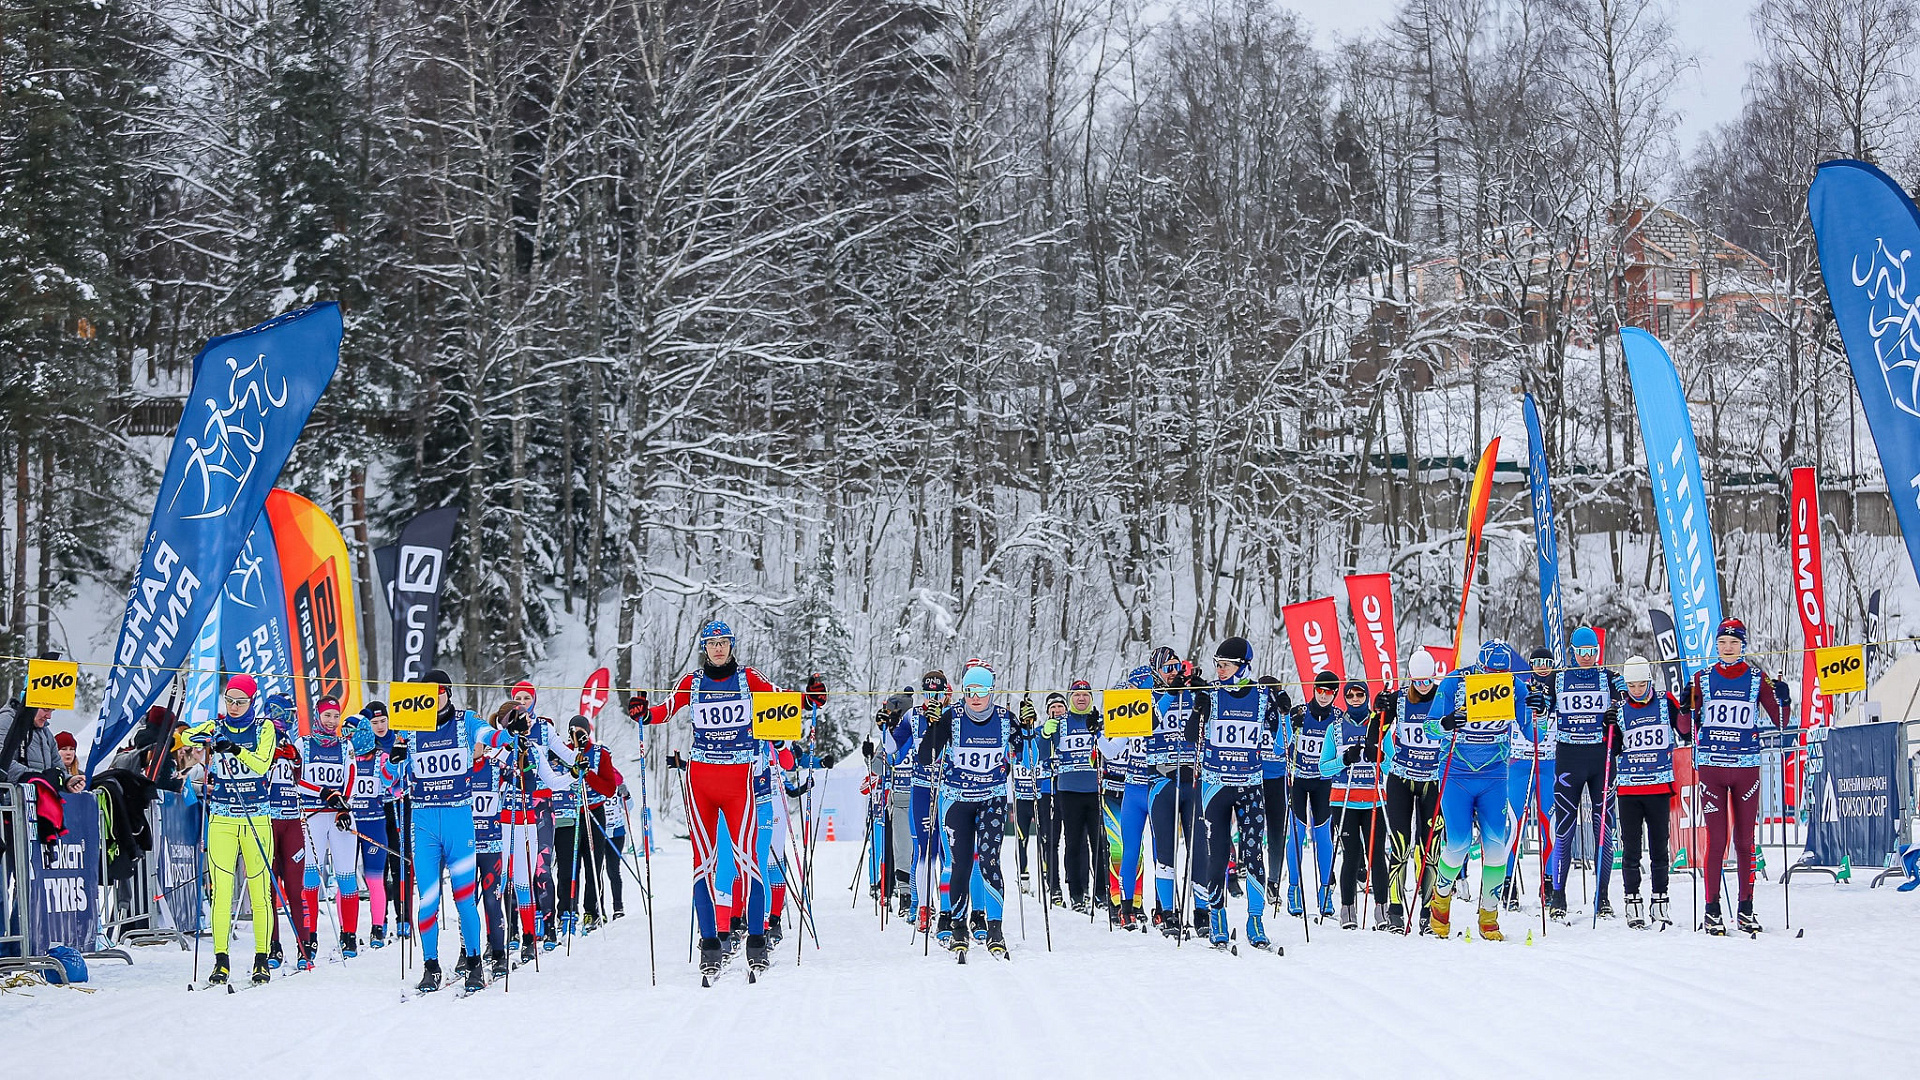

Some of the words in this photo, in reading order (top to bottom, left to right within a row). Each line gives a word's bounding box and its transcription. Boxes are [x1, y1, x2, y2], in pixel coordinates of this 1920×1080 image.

[1821, 656, 1860, 678] TOKO
[32, 672, 74, 690] TOKO
[393, 695, 435, 713] TOKO
[1469, 683, 1511, 705] TOKO
[1562, 695, 1604, 710] 1834
[700, 705, 745, 725] 1802
[756, 703, 799, 723] TOKO
[1107, 700, 1149, 721] TOKO
[1708, 704, 1751, 724] 1810
[1065, 737, 1093, 750] 184
[1216, 725, 1259, 745] 1814
[1628, 728, 1664, 749] 1858
[417, 752, 462, 775] 1806
[309, 766, 343, 783] 1808
[357, 779, 374, 795] 03
[44, 877, 88, 913] TYRES
